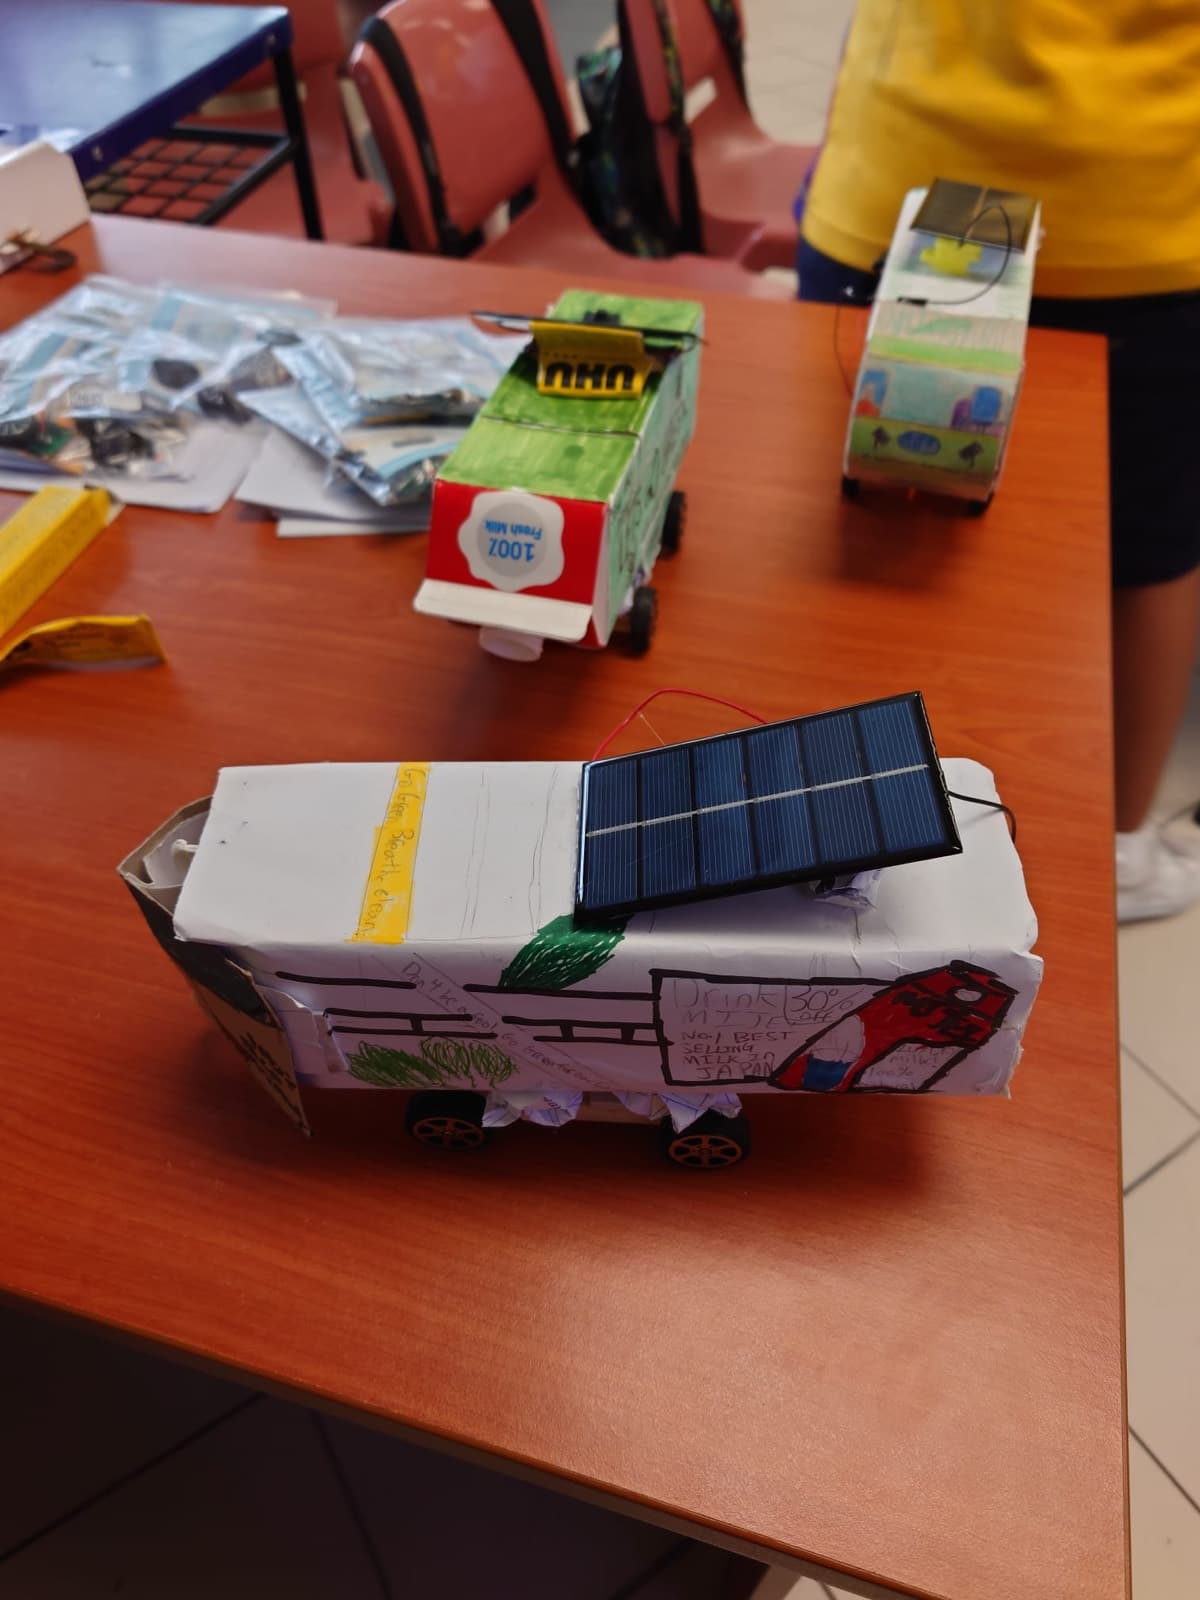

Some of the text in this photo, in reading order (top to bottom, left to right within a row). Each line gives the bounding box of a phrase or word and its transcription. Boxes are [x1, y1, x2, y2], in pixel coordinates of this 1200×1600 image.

[544, 361, 636, 391] UHU
[484, 519, 543, 540] Fresh Milk
[487, 537, 535, 562] 100%
[673, 979, 777, 1009] Drink
[734, 1031, 792, 1043] BEST
[681, 1042, 754, 1055] SELLING
[682, 1054, 739, 1066] MILK
[696, 1061, 775, 1081] JAPAN
